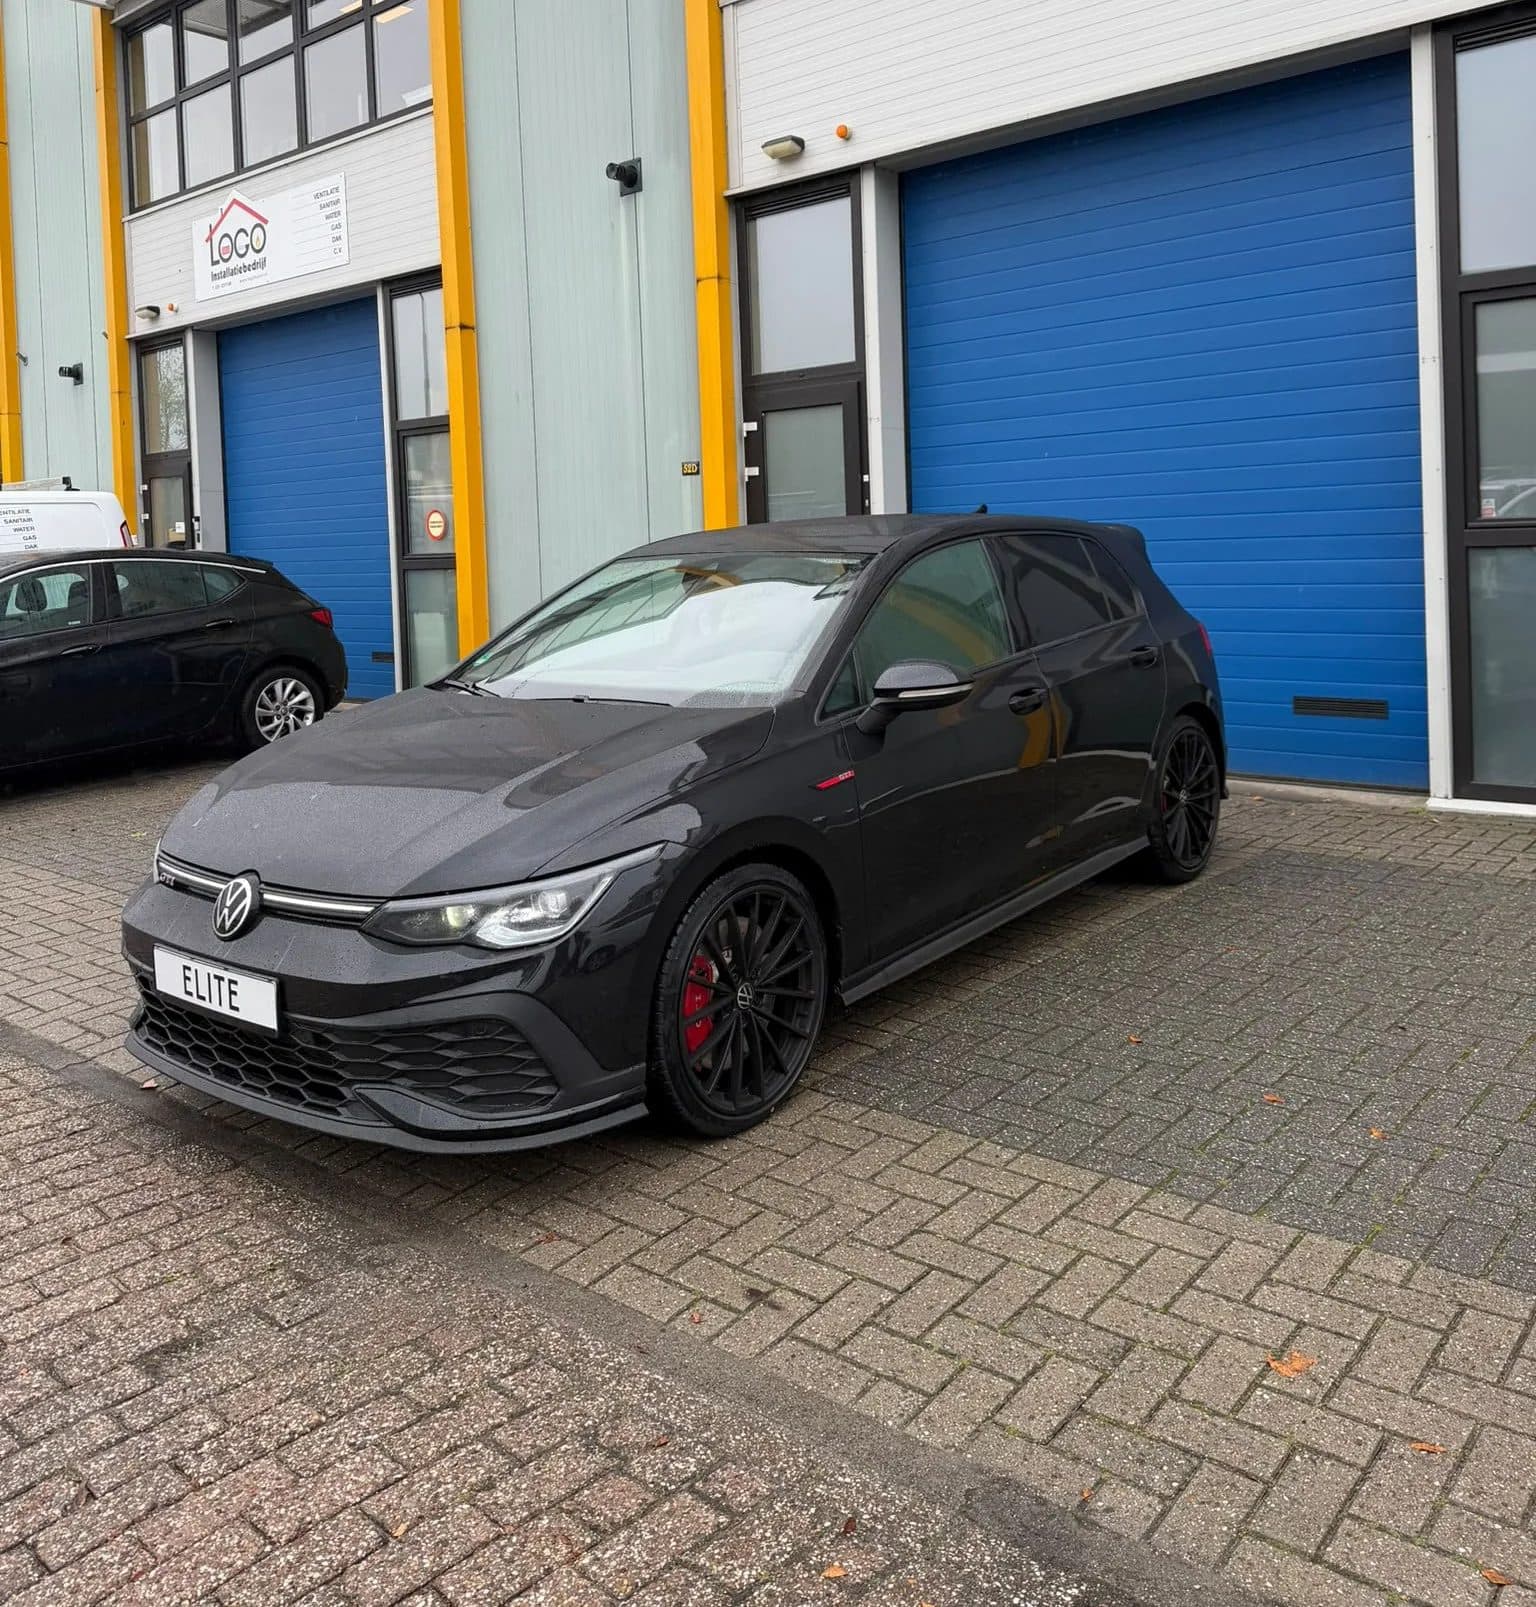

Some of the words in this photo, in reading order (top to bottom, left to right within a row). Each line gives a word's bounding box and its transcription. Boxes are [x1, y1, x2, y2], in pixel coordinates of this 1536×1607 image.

[313, 186, 340, 200] VENTILATIE
[319, 198, 341, 211] SANITAIR
[325, 210, 342, 221] WATER
[330, 221, 342, 232] GAS
[208, 222, 267, 267] LOGO
[331, 235, 342, 243] DAK
[211, 256, 267, 282] Installatiebedrijf
[3, 517, 34, 525] SANITAIR
[159, 871, 177, 887] GTI
[182, 964, 240, 1013] ELITE
